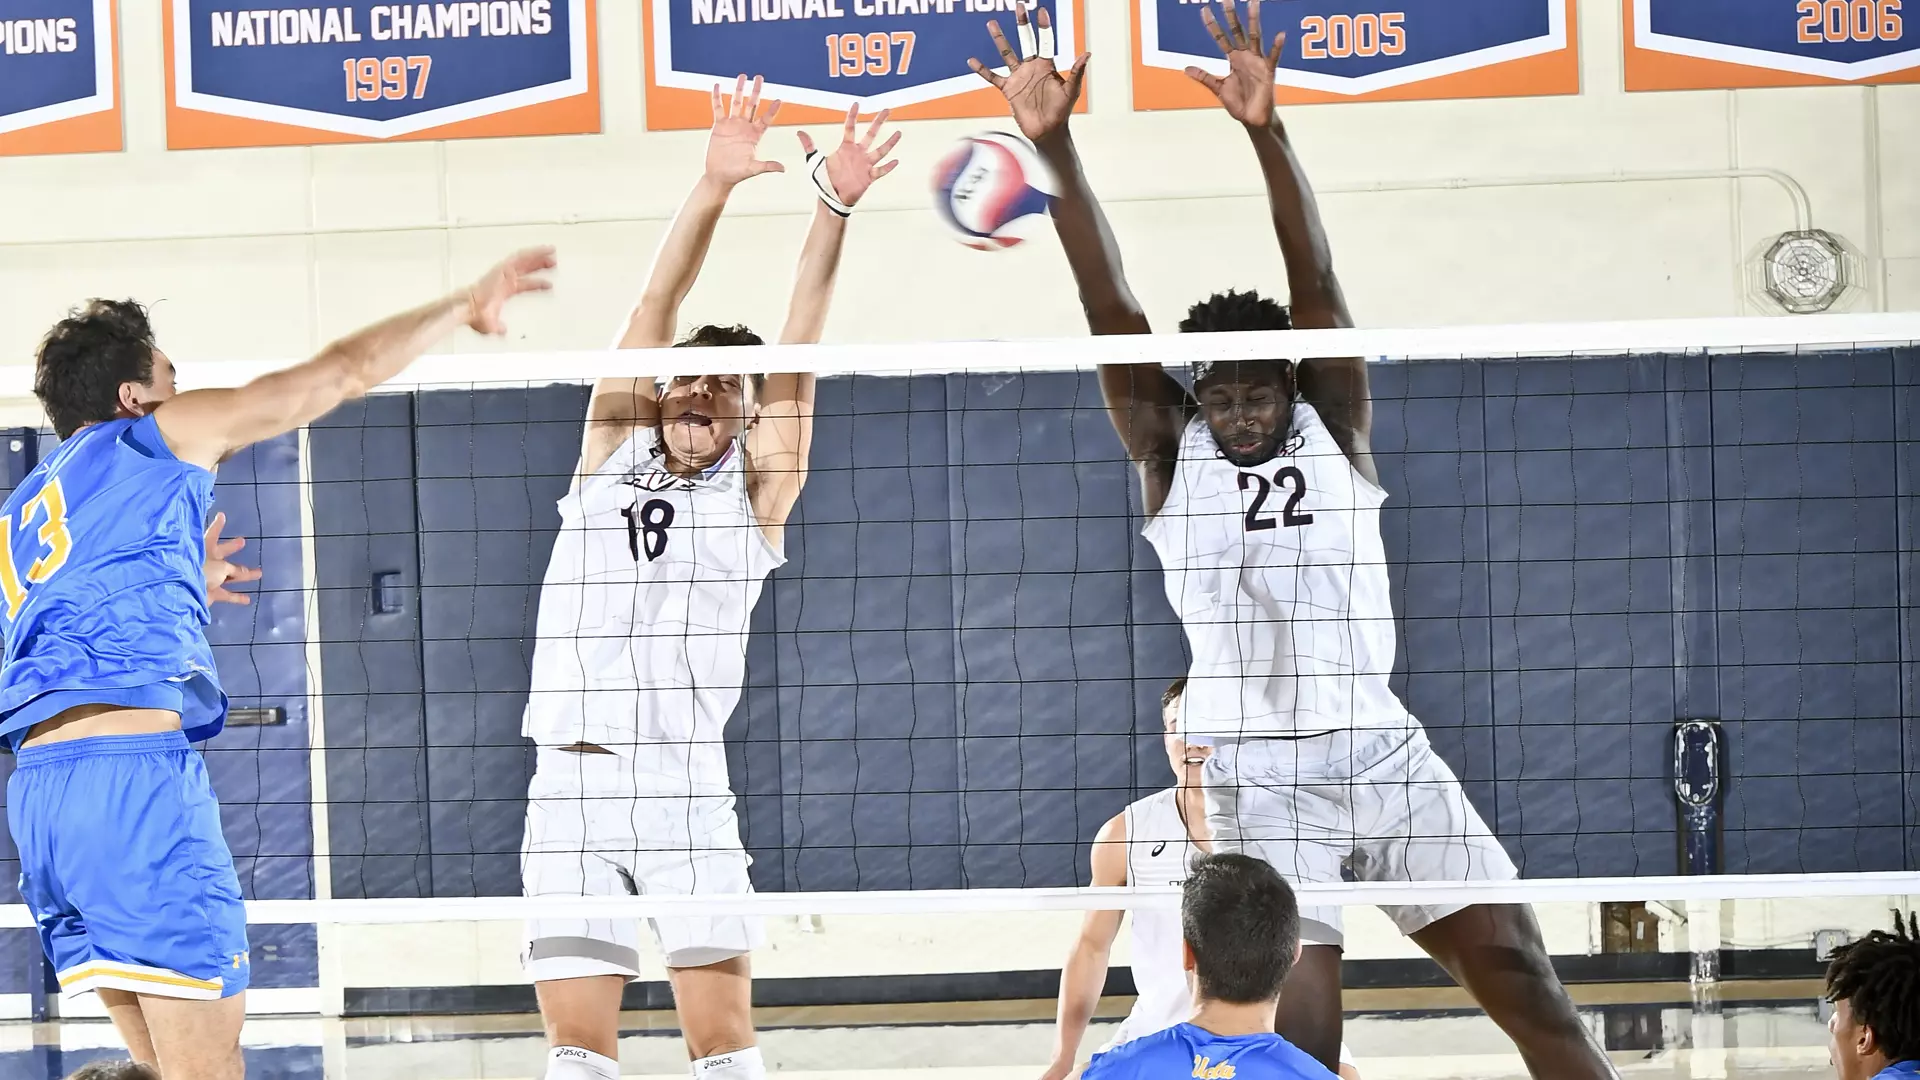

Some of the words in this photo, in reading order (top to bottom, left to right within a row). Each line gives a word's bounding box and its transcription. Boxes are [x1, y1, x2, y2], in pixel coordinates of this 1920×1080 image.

[0, 18, 77, 55] IONS
[211, 7, 362, 47] NATIONAL
[370, 0, 552, 41] CHAMPIONS
[1301, 12, 1406, 59] 2005
[1796, 0, 1902, 43] 2006
[826, 31, 916, 77] 1997
[343, 55, 432, 102] 1997
[1237, 466, 1313, 532] 22
[0, 476, 73, 623] 13
[621, 498, 675, 562] 18
